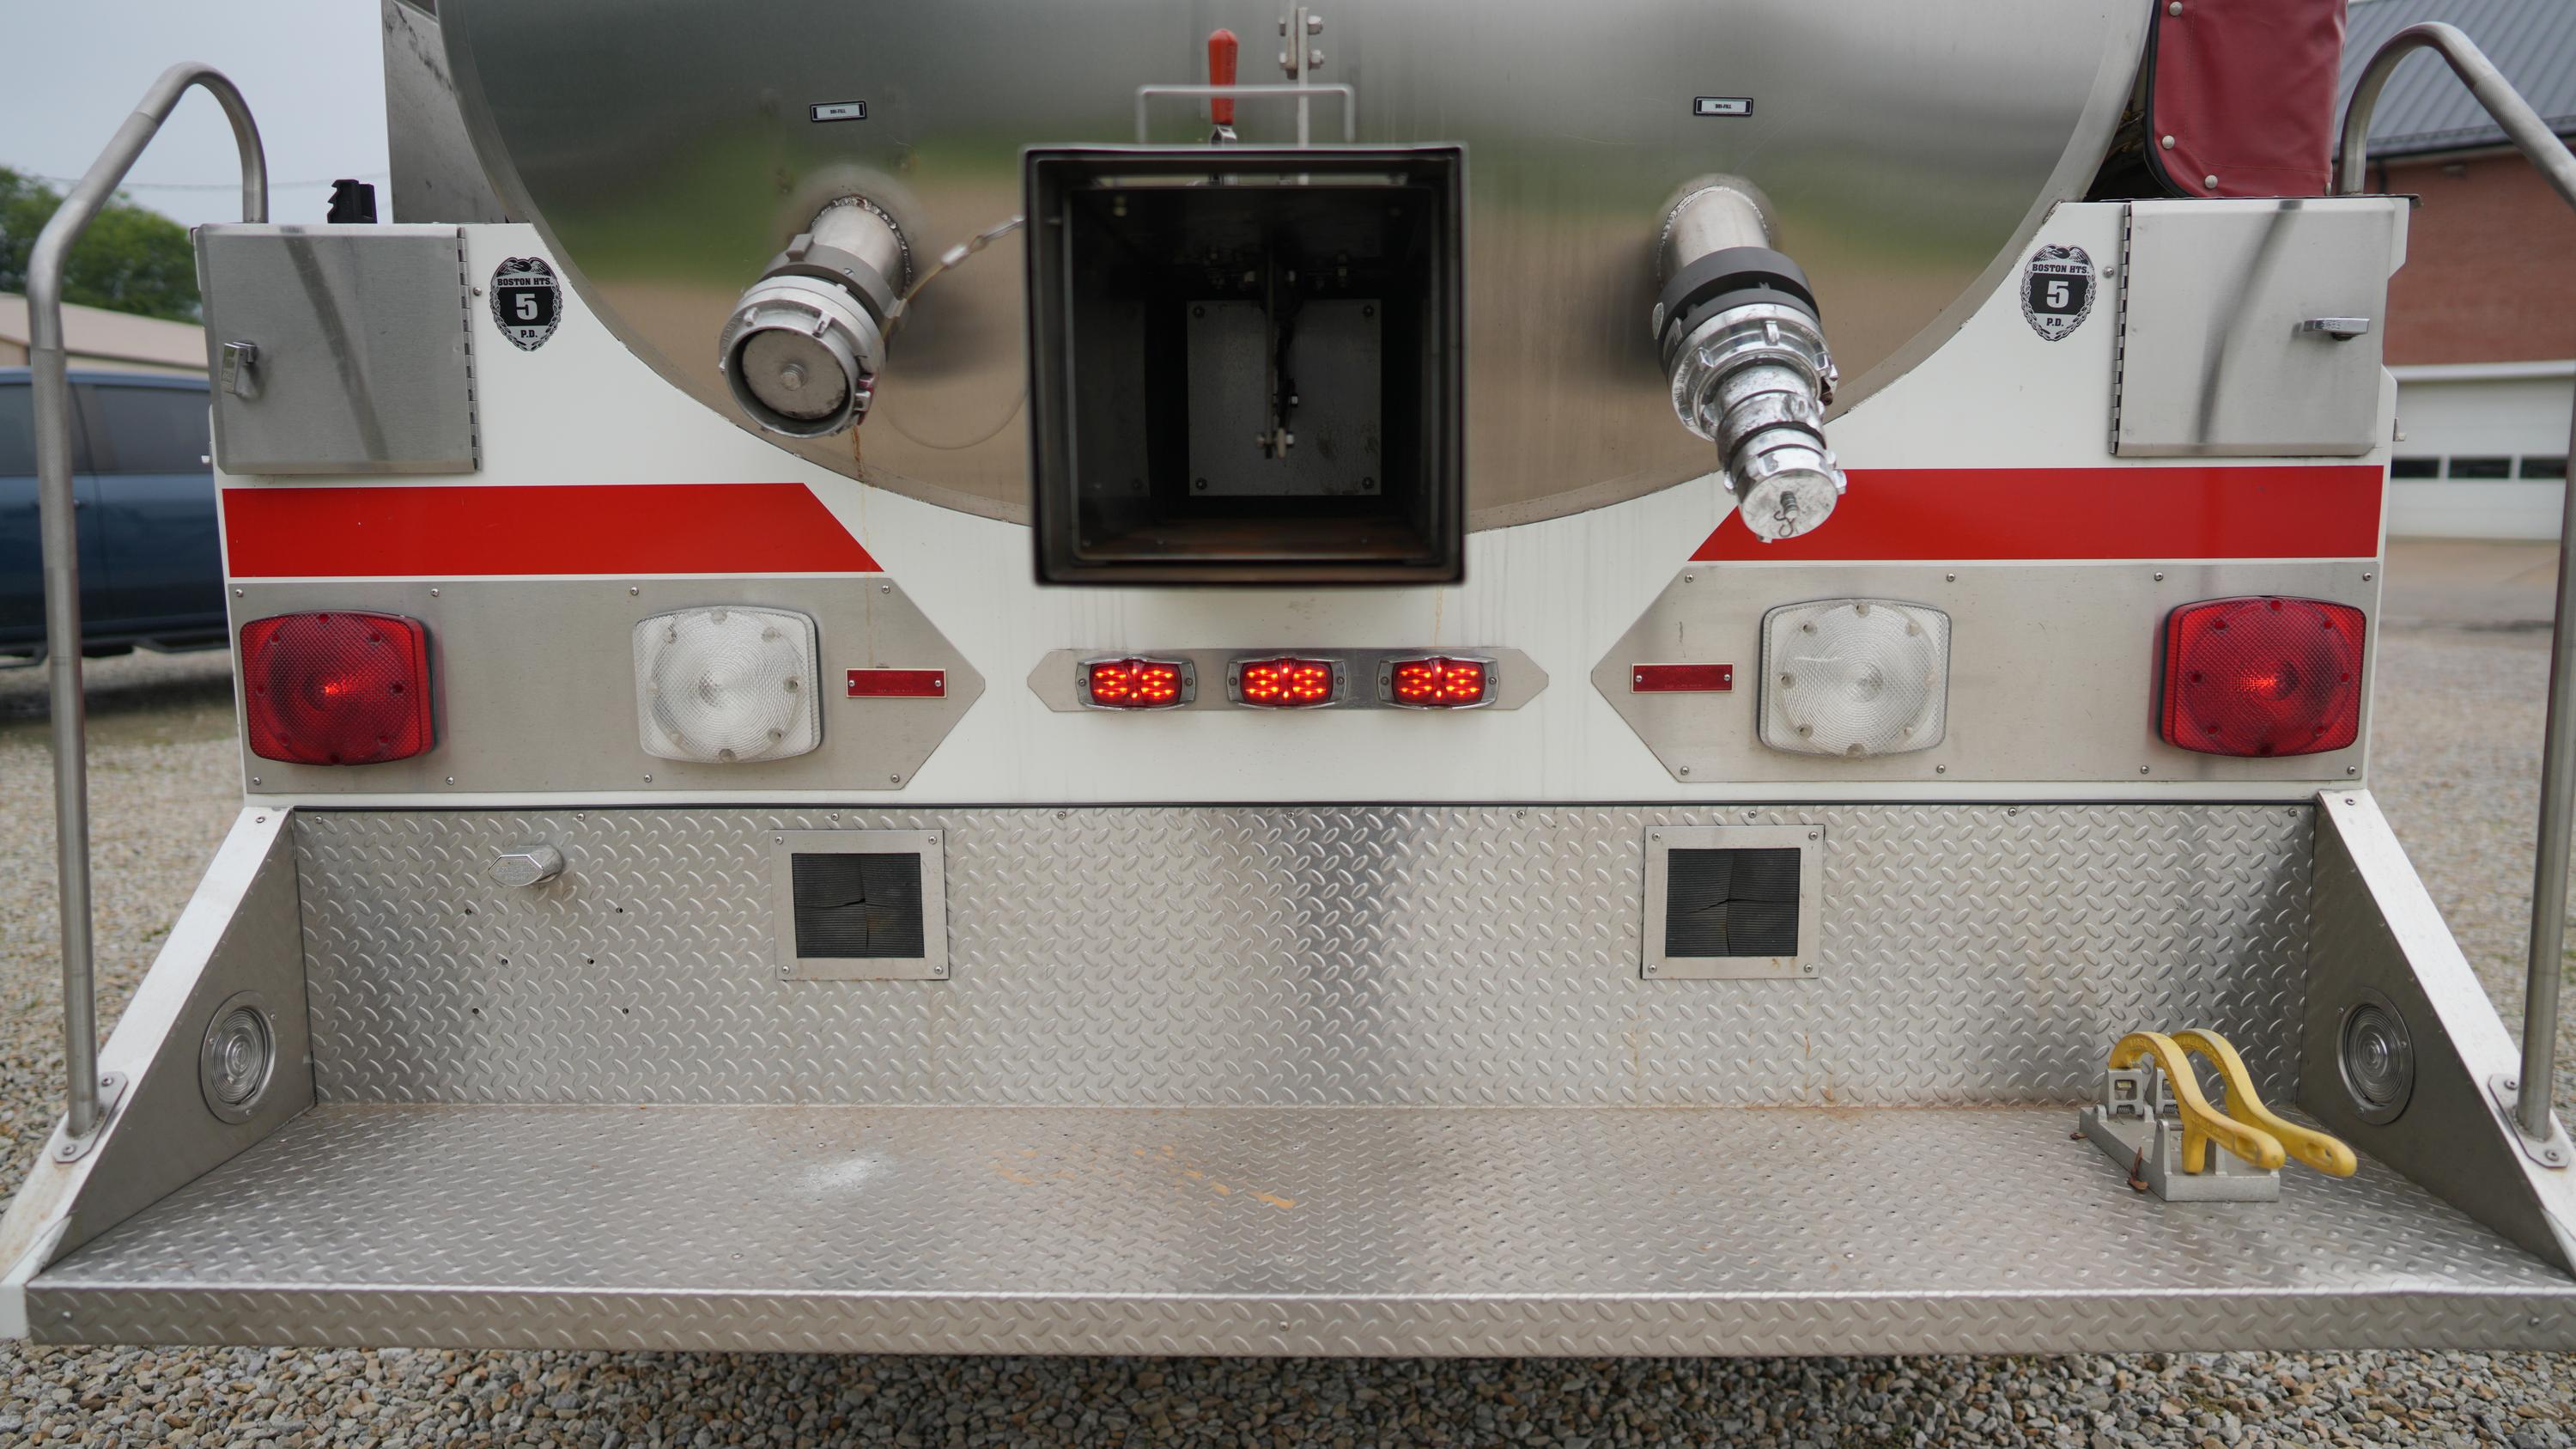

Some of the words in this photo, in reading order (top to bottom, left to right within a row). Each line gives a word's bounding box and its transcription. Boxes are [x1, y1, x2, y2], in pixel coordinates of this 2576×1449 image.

[2032, 264, 2067, 272] BOSTON
[2069, 265, 2089, 274] HTS.
[497, 277, 531, 286] BOSTON
[2046, 280, 2069, 308] 5
[515, 293, 538, 320] 5
[2046, 318, 2064, 326] P.D.
